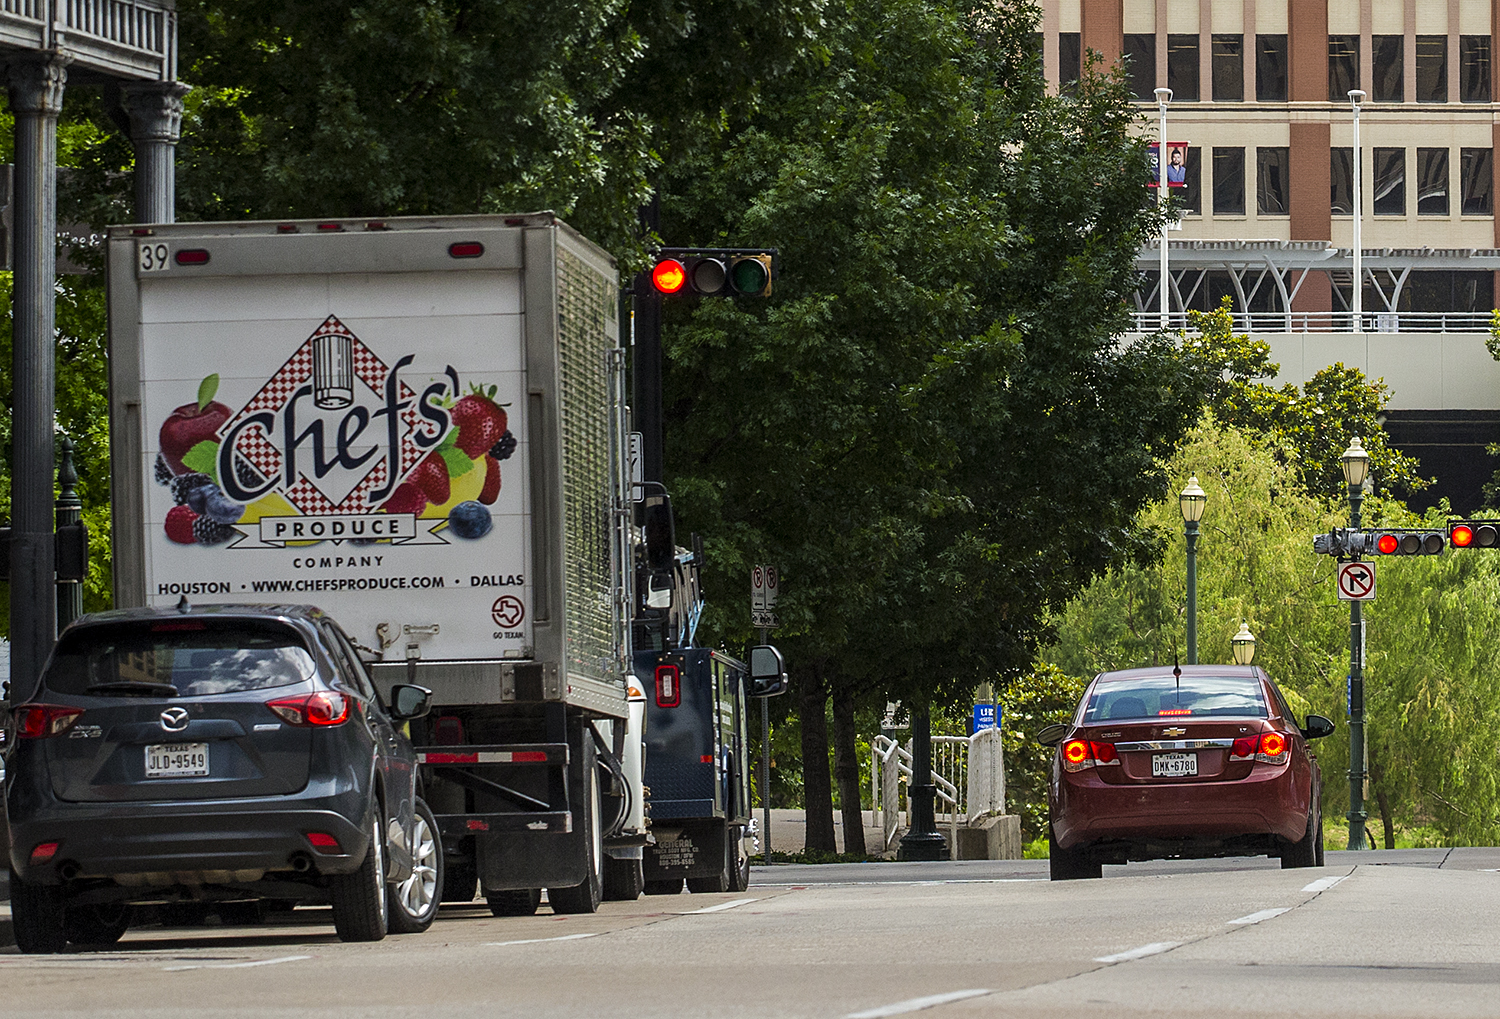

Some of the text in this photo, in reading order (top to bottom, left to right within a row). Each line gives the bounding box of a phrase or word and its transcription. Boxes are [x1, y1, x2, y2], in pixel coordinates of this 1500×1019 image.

[142, 244, 168, 270] 39
[275, 519, 400, 537] PRODUCE
[293, 555, 384, 569] COMPANY
[158, 575, 524, 595] HOUSTON WWW.CHEFSPRODUCE.COM DALLAS
